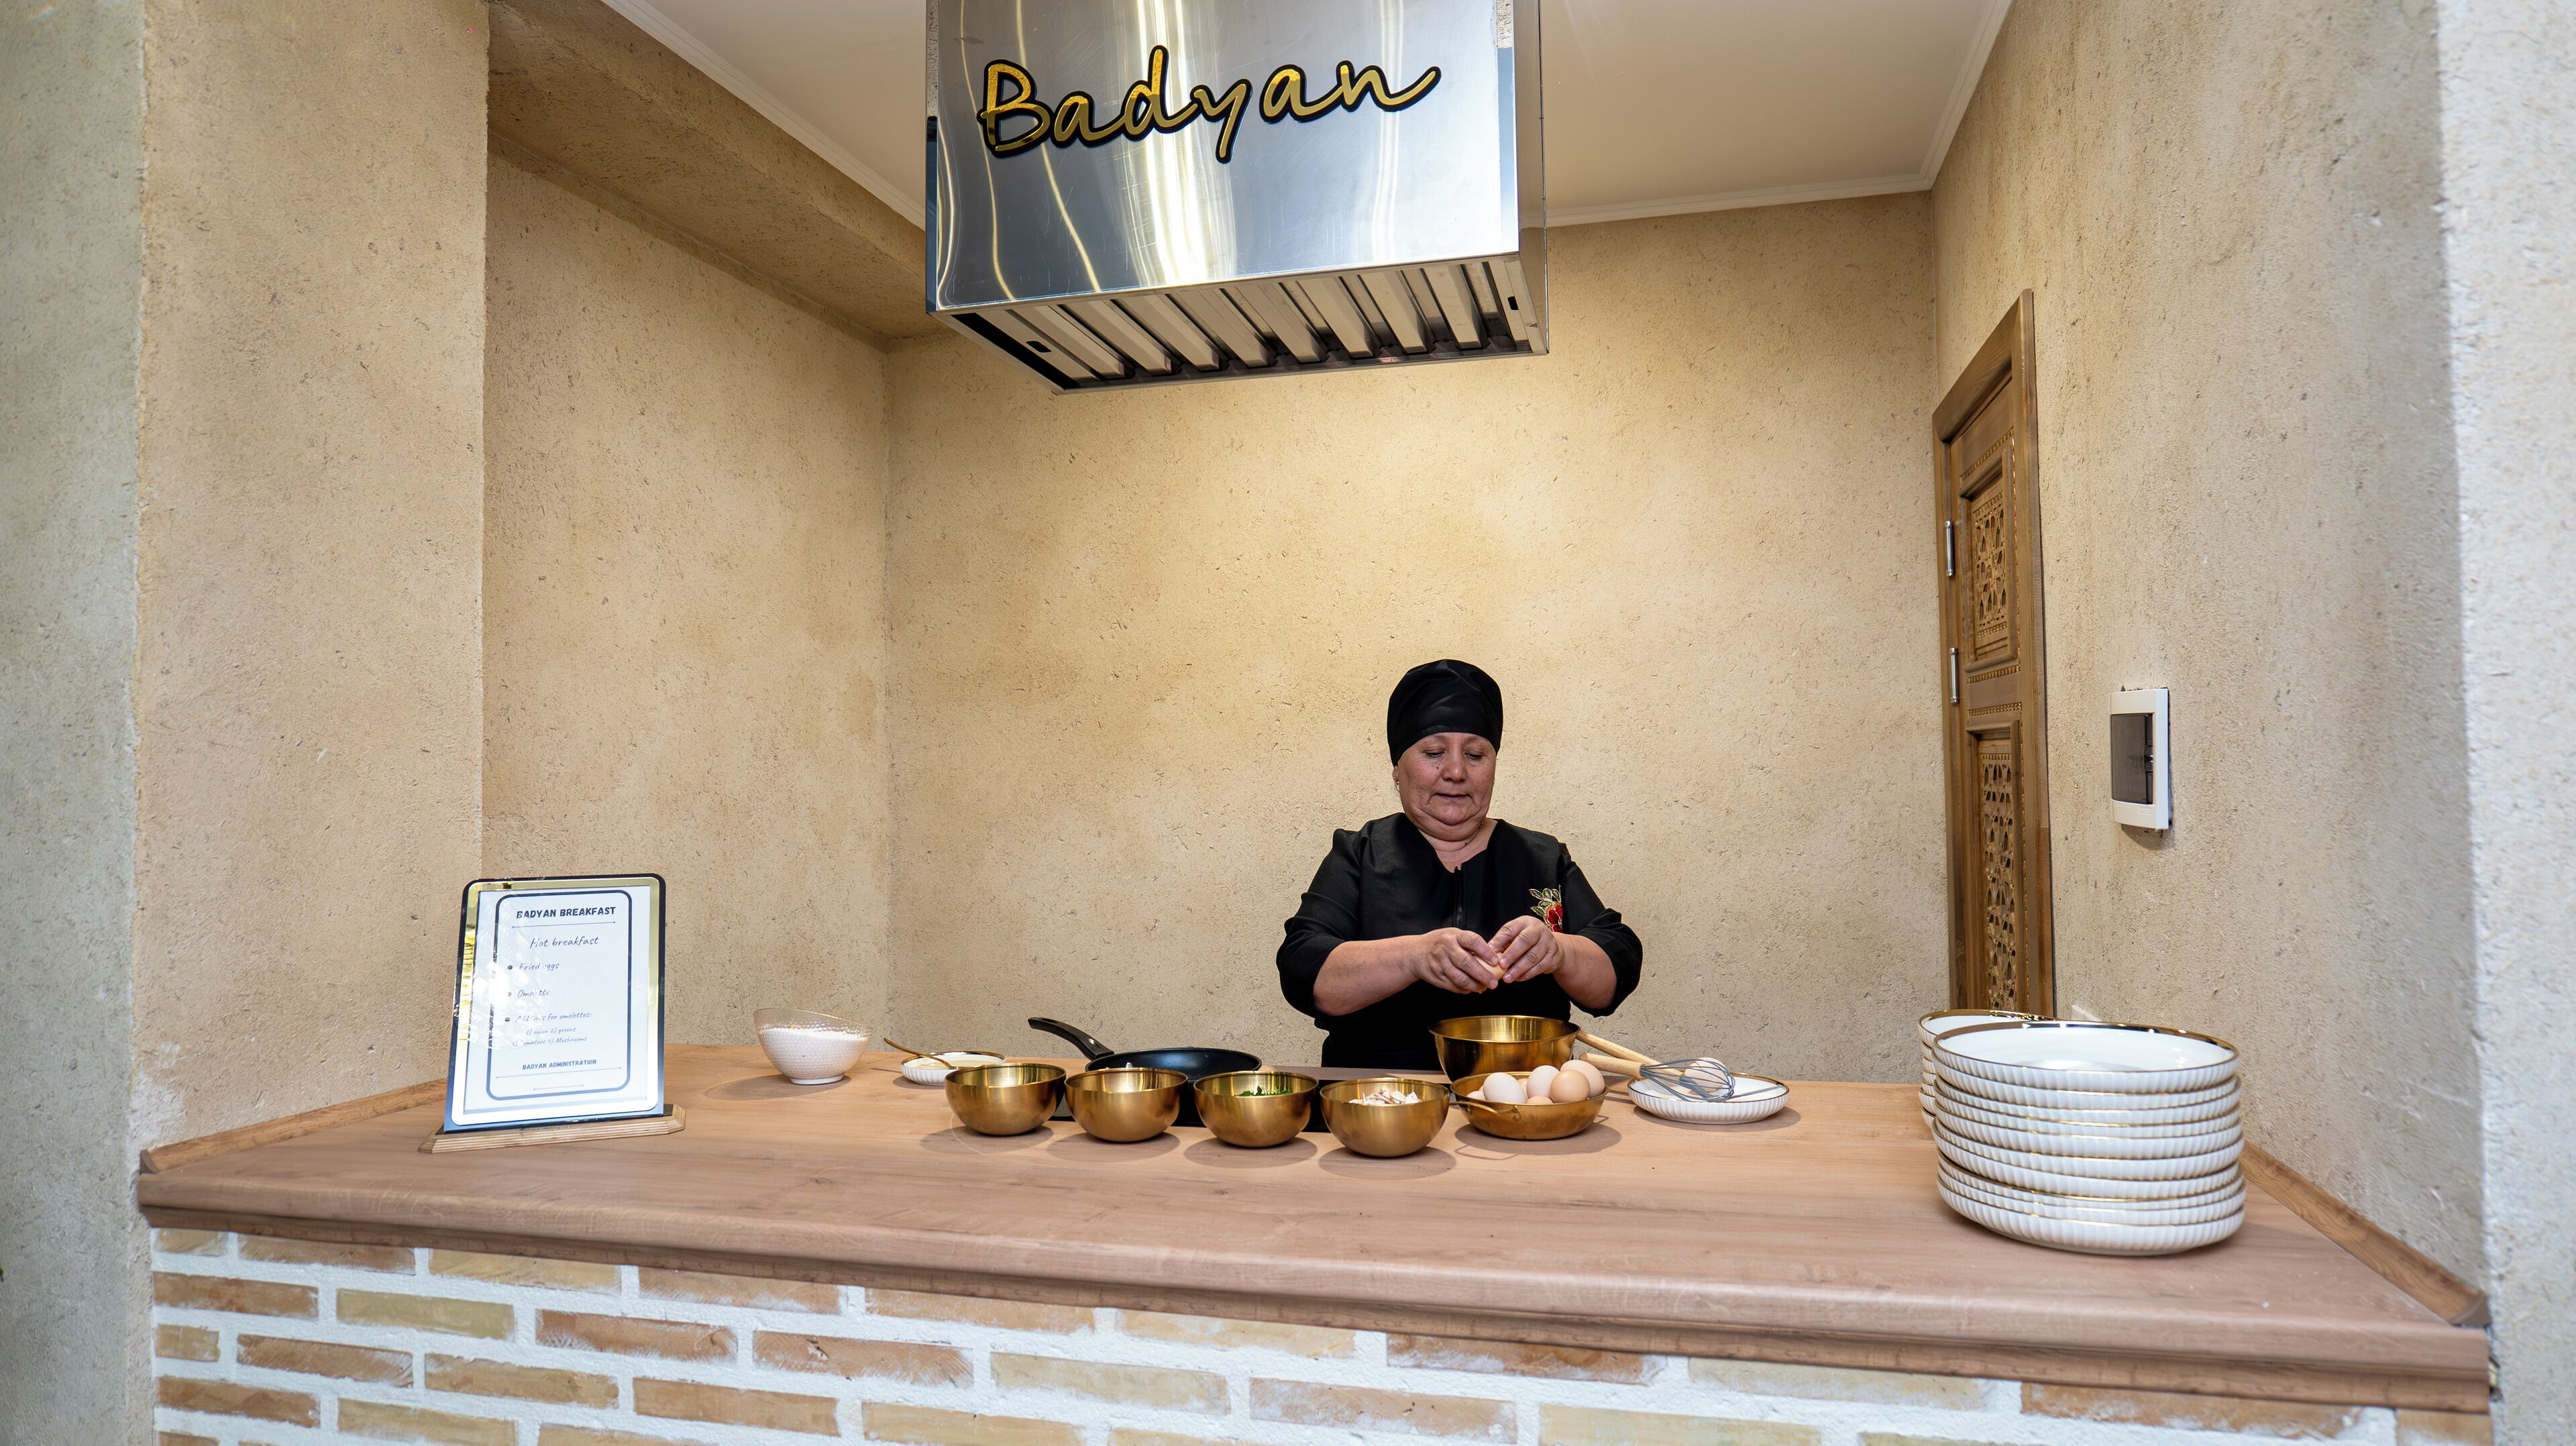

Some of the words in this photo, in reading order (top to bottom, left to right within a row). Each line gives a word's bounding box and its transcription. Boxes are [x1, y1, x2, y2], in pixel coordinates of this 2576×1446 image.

[977, 45, 1441, 163] Badyan
[516, 909, 555, 919] BADYAN
[559, 907, 616, 917] BREAKFAST
[530, 938, 547, 949] Hot
[551, 936, 598, 946] breakfast
[519, 962, 539, 970] Fried
[517, 988, 549, 998] Omeltte
[547, 1013, 557, 1021] for
[559, 1012, 592, 1020] omelettes:
[558, 1027, 576, 1035] greens
[549, 1060, 596, 1068] ADMINISTRATION
